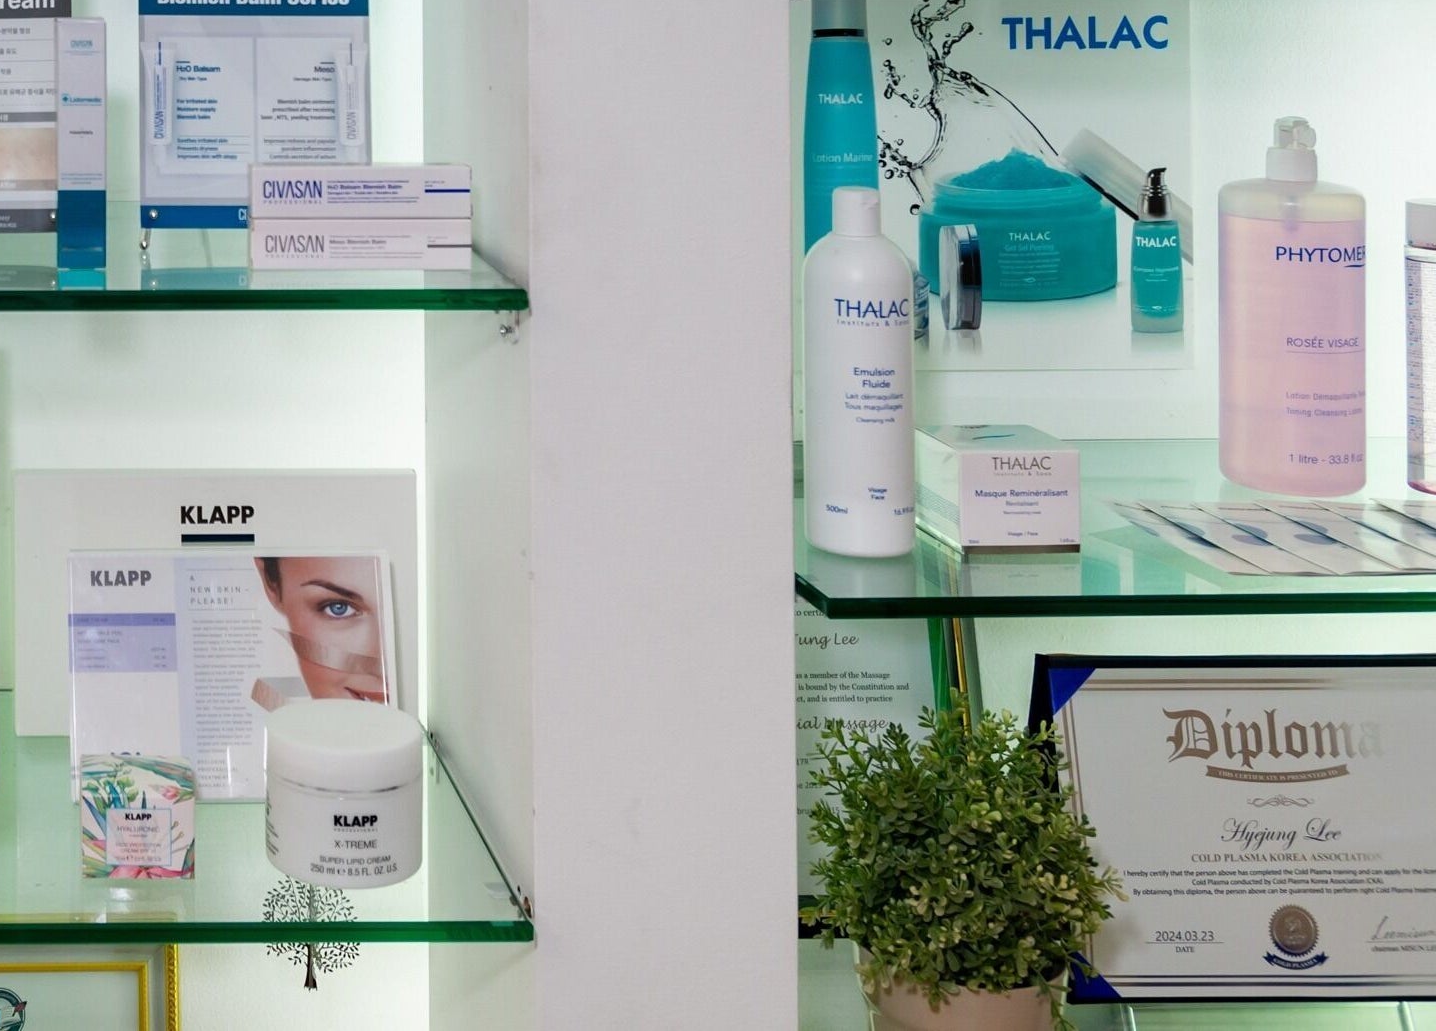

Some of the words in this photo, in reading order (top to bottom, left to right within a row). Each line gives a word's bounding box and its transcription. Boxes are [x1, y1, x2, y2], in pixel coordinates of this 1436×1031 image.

[1001, 15, 1169, 51] THALAC
[818, 93, 863, 105] THALAC
[263, 180, 322, 199] CIVASAN
[1008, 231, 1052, 241] THALAC
[1135, 236, 1176, 247] THALAC
[265, 234, 325, 253] CIVASAN
[834, 298, 908, 318] THALAC
[1286, 335, 1324, 349] ROSÉE
[1327, 336, 1359, 348] VISAGE
[854, 368, 895, 376] Emulsion
[862, 380, 890, 388] Fluide
[992, 456, 1052, 470] THALAC
[975, 490, 1007, 498] Masque
[180, 505, 255, 525] KLAPP
[90, 570, 152, 587] KLAPP
[834, 633, 859, 645] Lee
[861, 672, 890, 680] Massage
[828, 683, 837, 692] by
[852, 683, 894, 691] Constitution
[865, 696, 892, 704] practice
[1162, 708, 1386, 769] Diploma
[125, 813, 152, 821] KLAPP
[333, 815, 378, 827] KLAPP
[1221, 817, 1297, 850] Hyejung
[1303, 817, 1342, 842] Lee
[335, 840, 378, 849] X-TREME
[1191, 853, 1222, 863] COLD
[1224, 853, 1266, 863] PLASMA
[1269, 853, 1308, 863] KOREA
[1155, 930, 1215, 943] 2024.03.23
